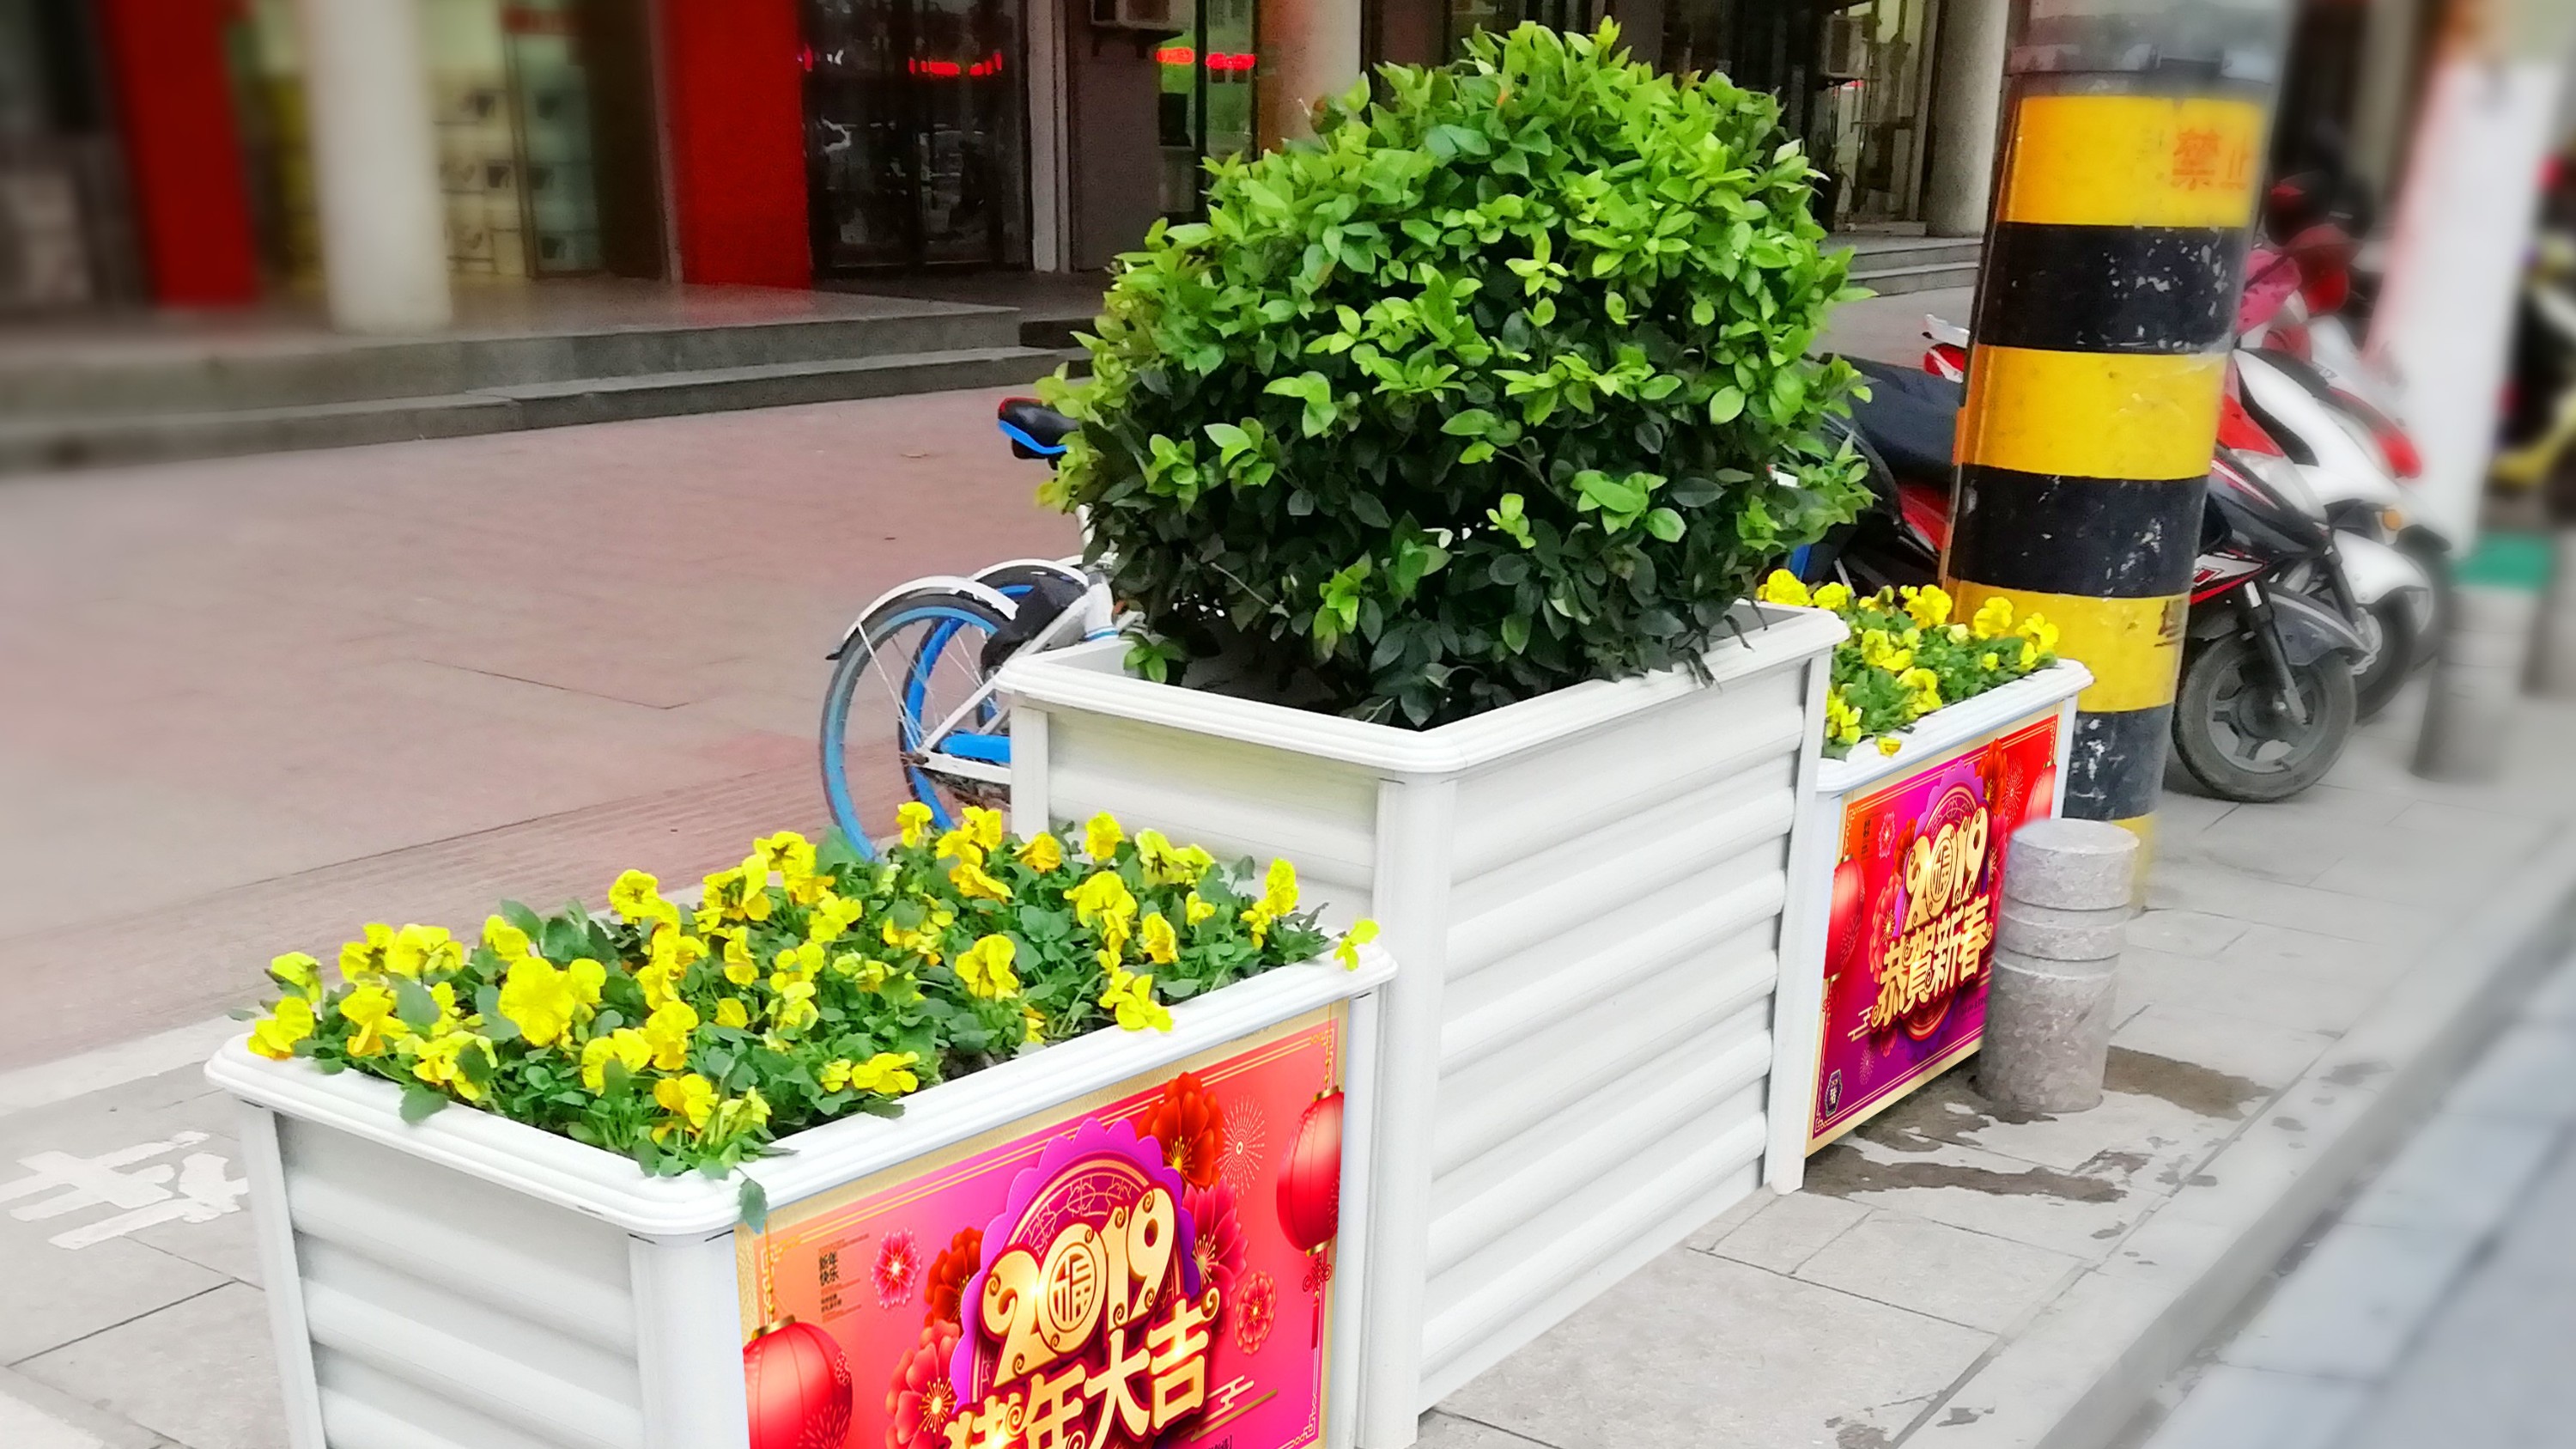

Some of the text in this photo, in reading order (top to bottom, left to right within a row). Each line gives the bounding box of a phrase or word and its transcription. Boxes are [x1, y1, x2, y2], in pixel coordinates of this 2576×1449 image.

[2169, 127, 2249, 191] 禁止
[1904, 806, 1989, 933] 2019
[1870, 894, 1993, 1027] 恭賀新春
[982, 1188, 1176, 1388] 2019
[1048, 1251, 1095, 1328] 福
